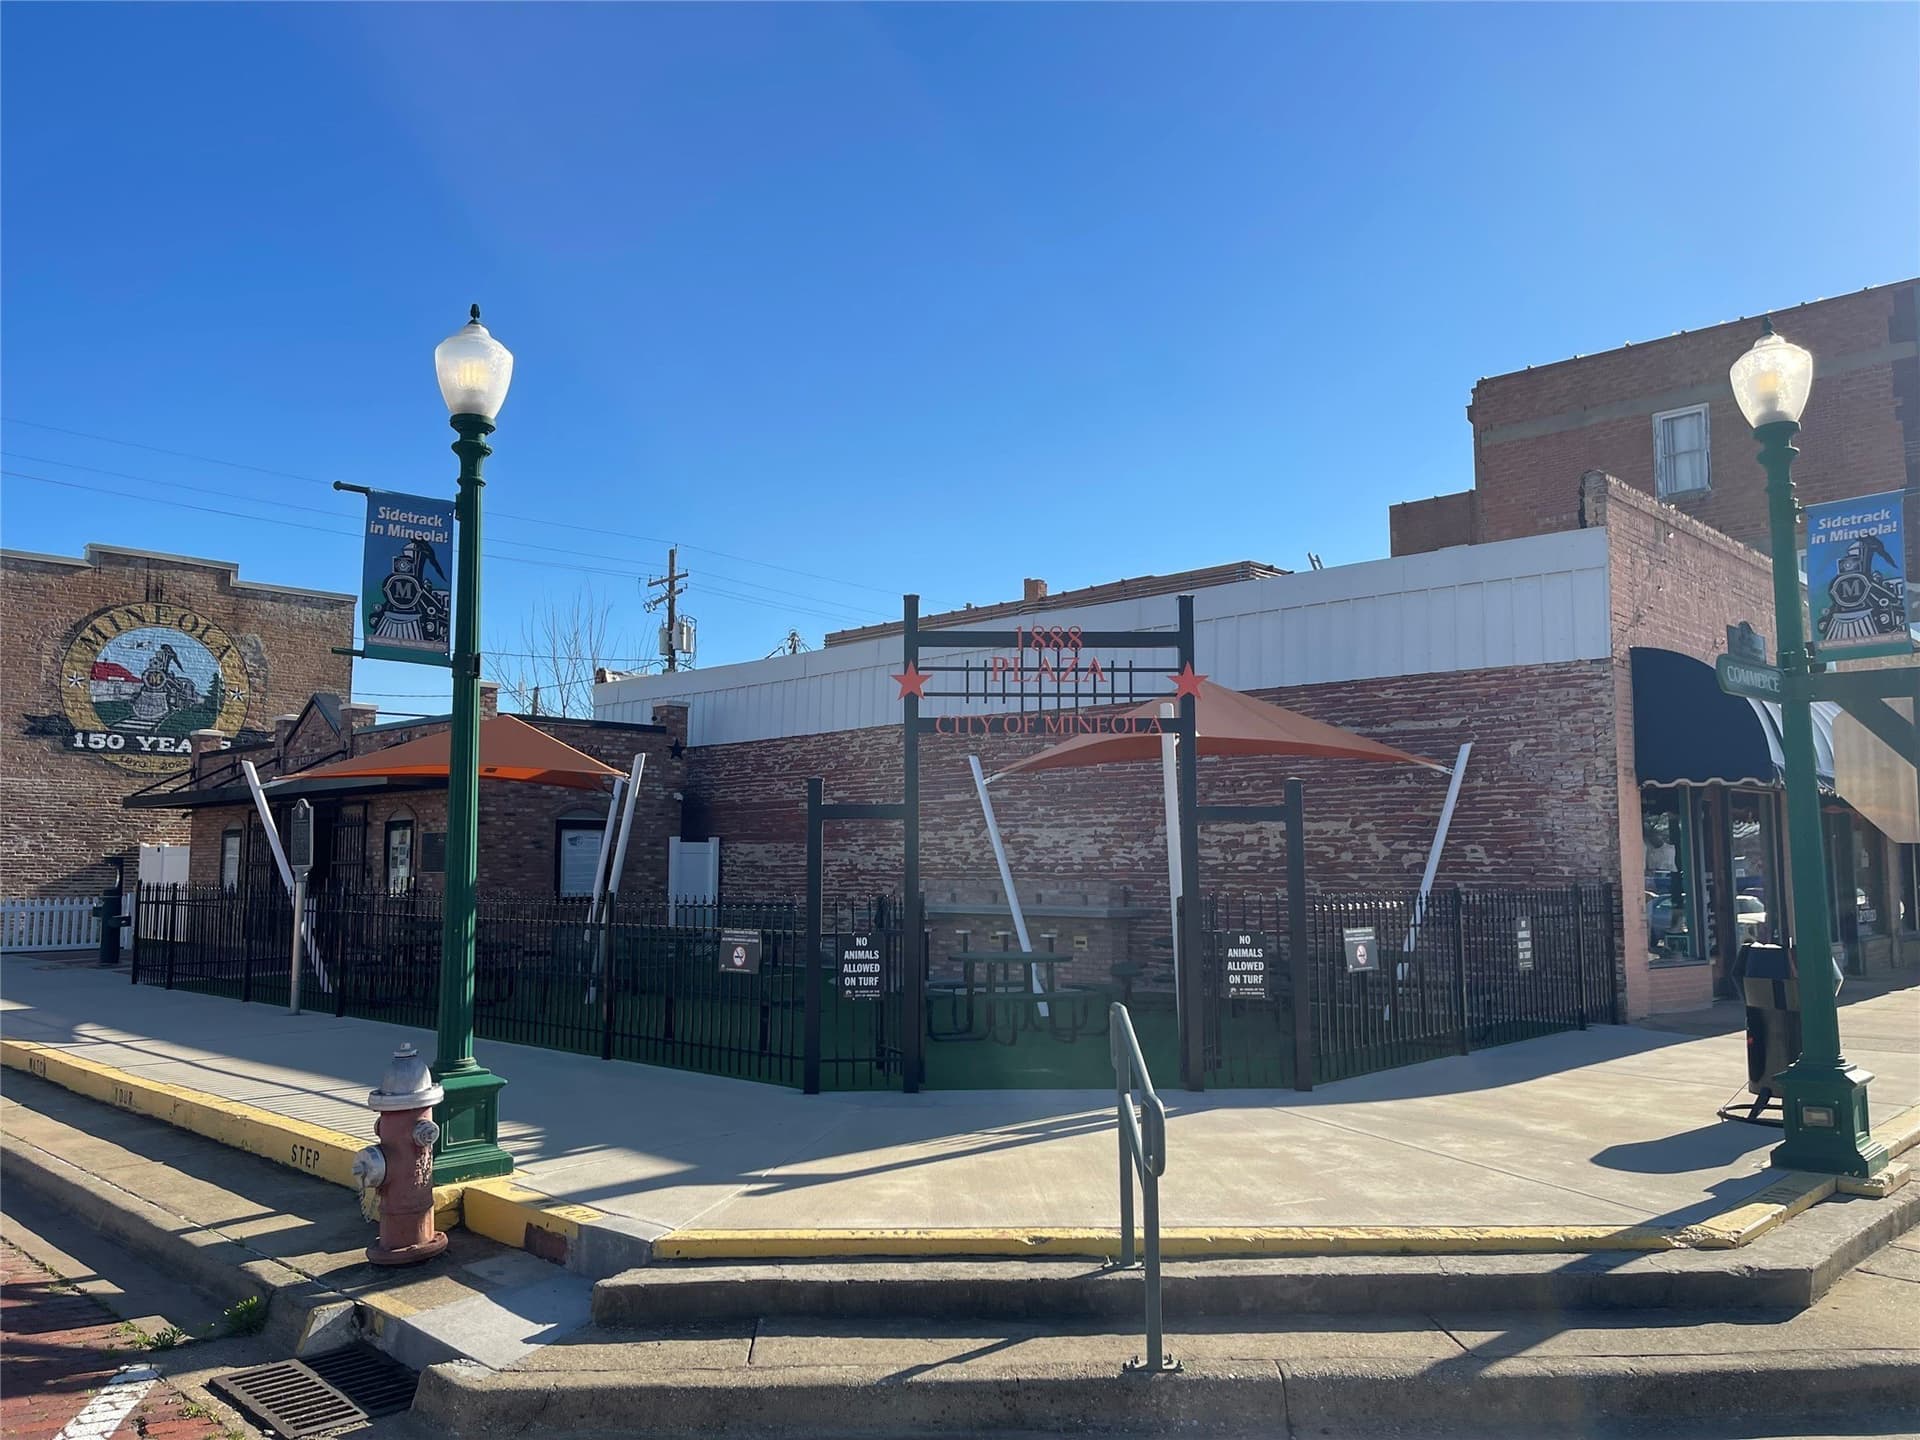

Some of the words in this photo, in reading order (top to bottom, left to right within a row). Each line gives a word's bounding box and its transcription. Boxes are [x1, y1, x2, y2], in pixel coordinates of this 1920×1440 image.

[378, 506, 443, 528] Sidetrack
[1818, 508, 1891, 531] Sidetrack
[369, 520, 384, 536] in
[387, 523, 449, 544] Mineola!
[1811, 532, 1826, 545] in
[1829, 521, 1898, 542] Mineola!
[395, 581, 413, 600] M
[1841, 581, 1860, 598] M
[79, 604, 232, 661] MINEOLA
[1015, 625, 1084, 651] 1888
[991, 656, 1107, 682] PLAZA
[1727, 666, 1781, 693] COMMERCE
[935, 715, 994, 735] CITY
[1003, 715, 1035, 735] OF
[1043, 715, 1163, 735] MINEOLA
[73, 732, 126, 750] 150
[855, 937, 868, 946] NO
[1239, 935, 1251, 945] NO
[844, 950, 880, 960] ANIMALS
[1227, 948, 1263, 959] ANIMALS
[843, 963, 880, 973] ALLOWED
[1227, 961, 1264, 972] ALLOWED
[844, 977, 856, 986] ON
[858, 976, 879, 986] TURF
[1229, 974, 1241, 985] ON
[1242, 974, 1264, 985] TURF
[291, 1144, 321, 1170] STEP
